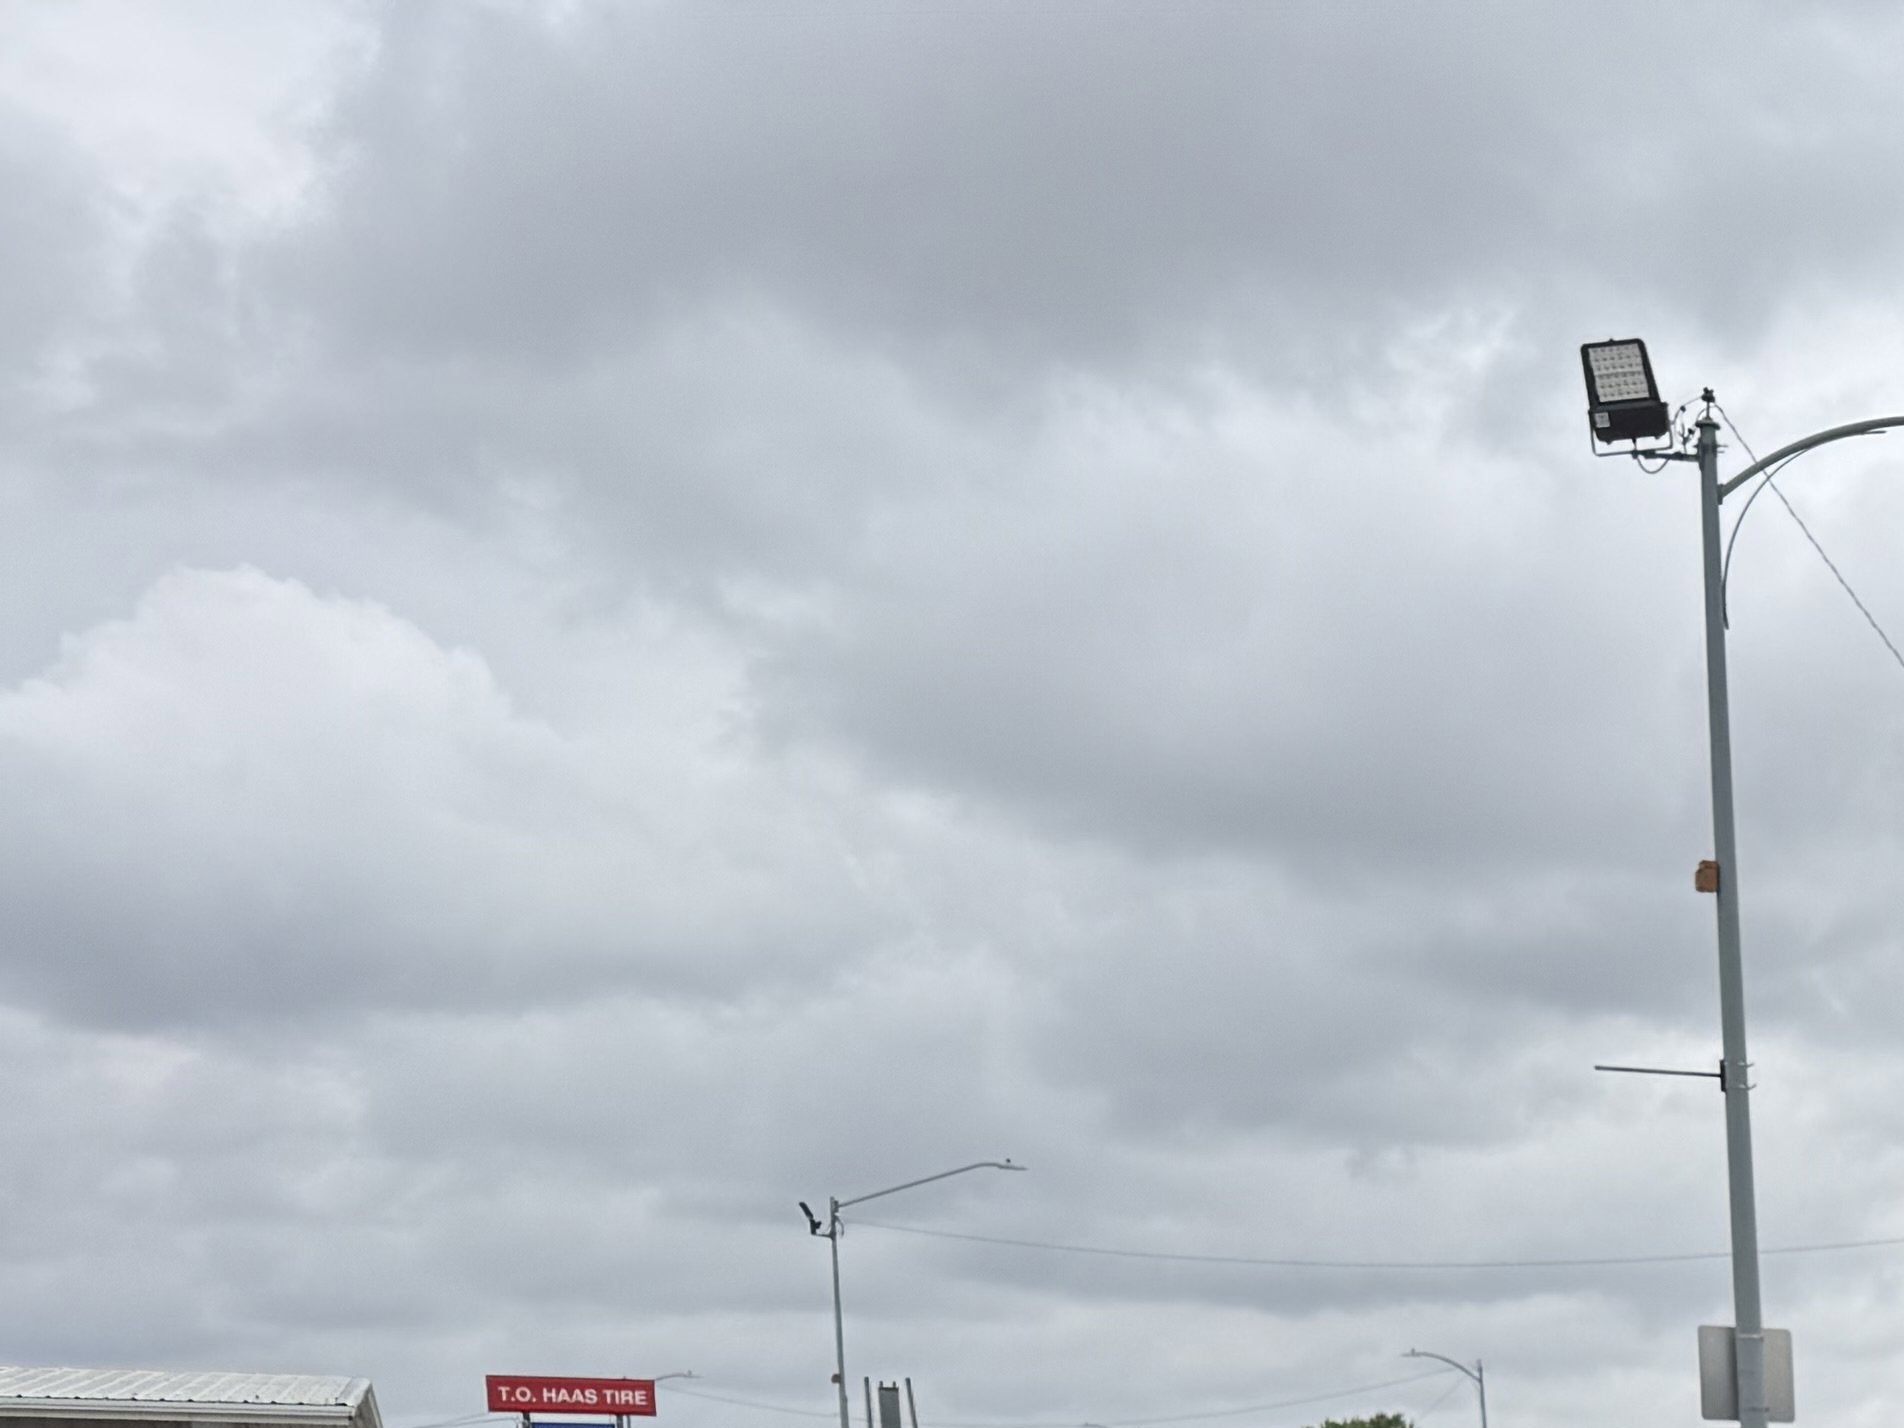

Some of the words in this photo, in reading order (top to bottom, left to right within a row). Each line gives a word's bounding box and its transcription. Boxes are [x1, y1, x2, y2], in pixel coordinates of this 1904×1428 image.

[498, 1386, 536, 1402] T.O.
[542, 1388, 598, 1404] HAAS
[603, 1389, 648, 1405] TIRE
